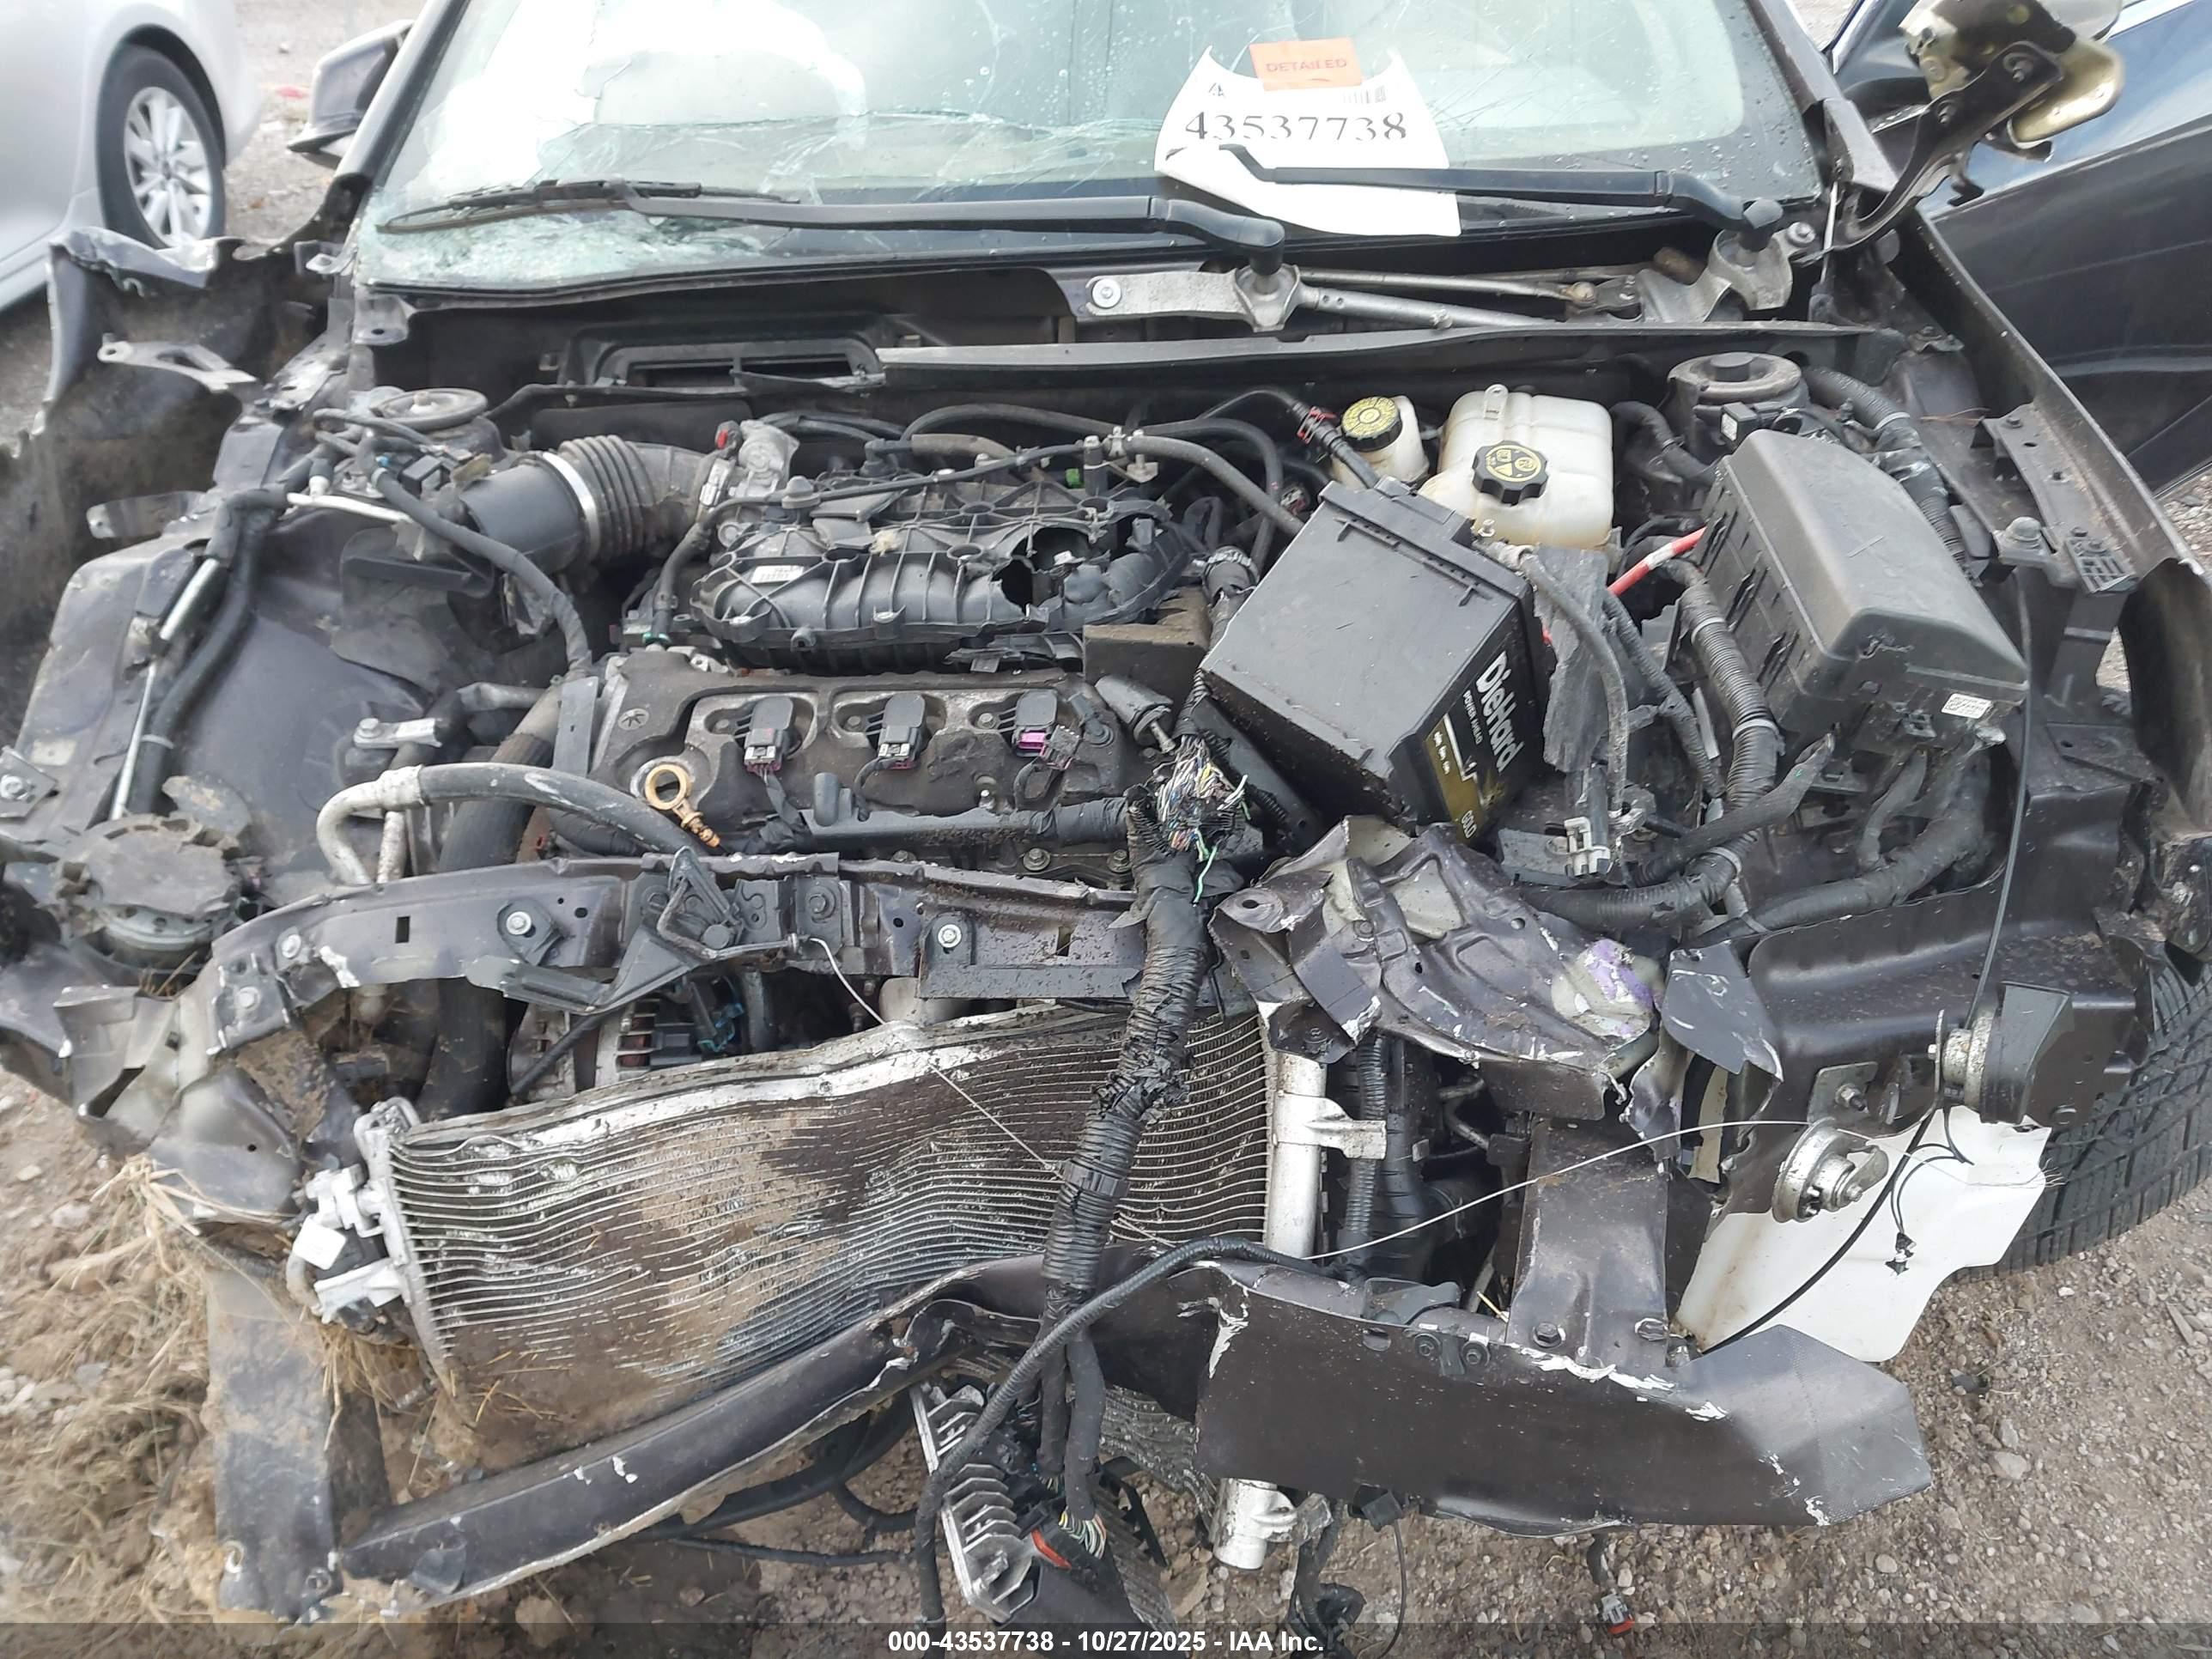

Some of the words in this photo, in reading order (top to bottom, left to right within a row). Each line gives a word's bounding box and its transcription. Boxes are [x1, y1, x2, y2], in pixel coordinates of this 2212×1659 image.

[1266, 58, 1347, 72] DETAILED
[1185, 111, 1407, 141] 43537738
[1475, 650, 1525, 774] DieHard
[1462, 810, 1478, 839] GOLD
